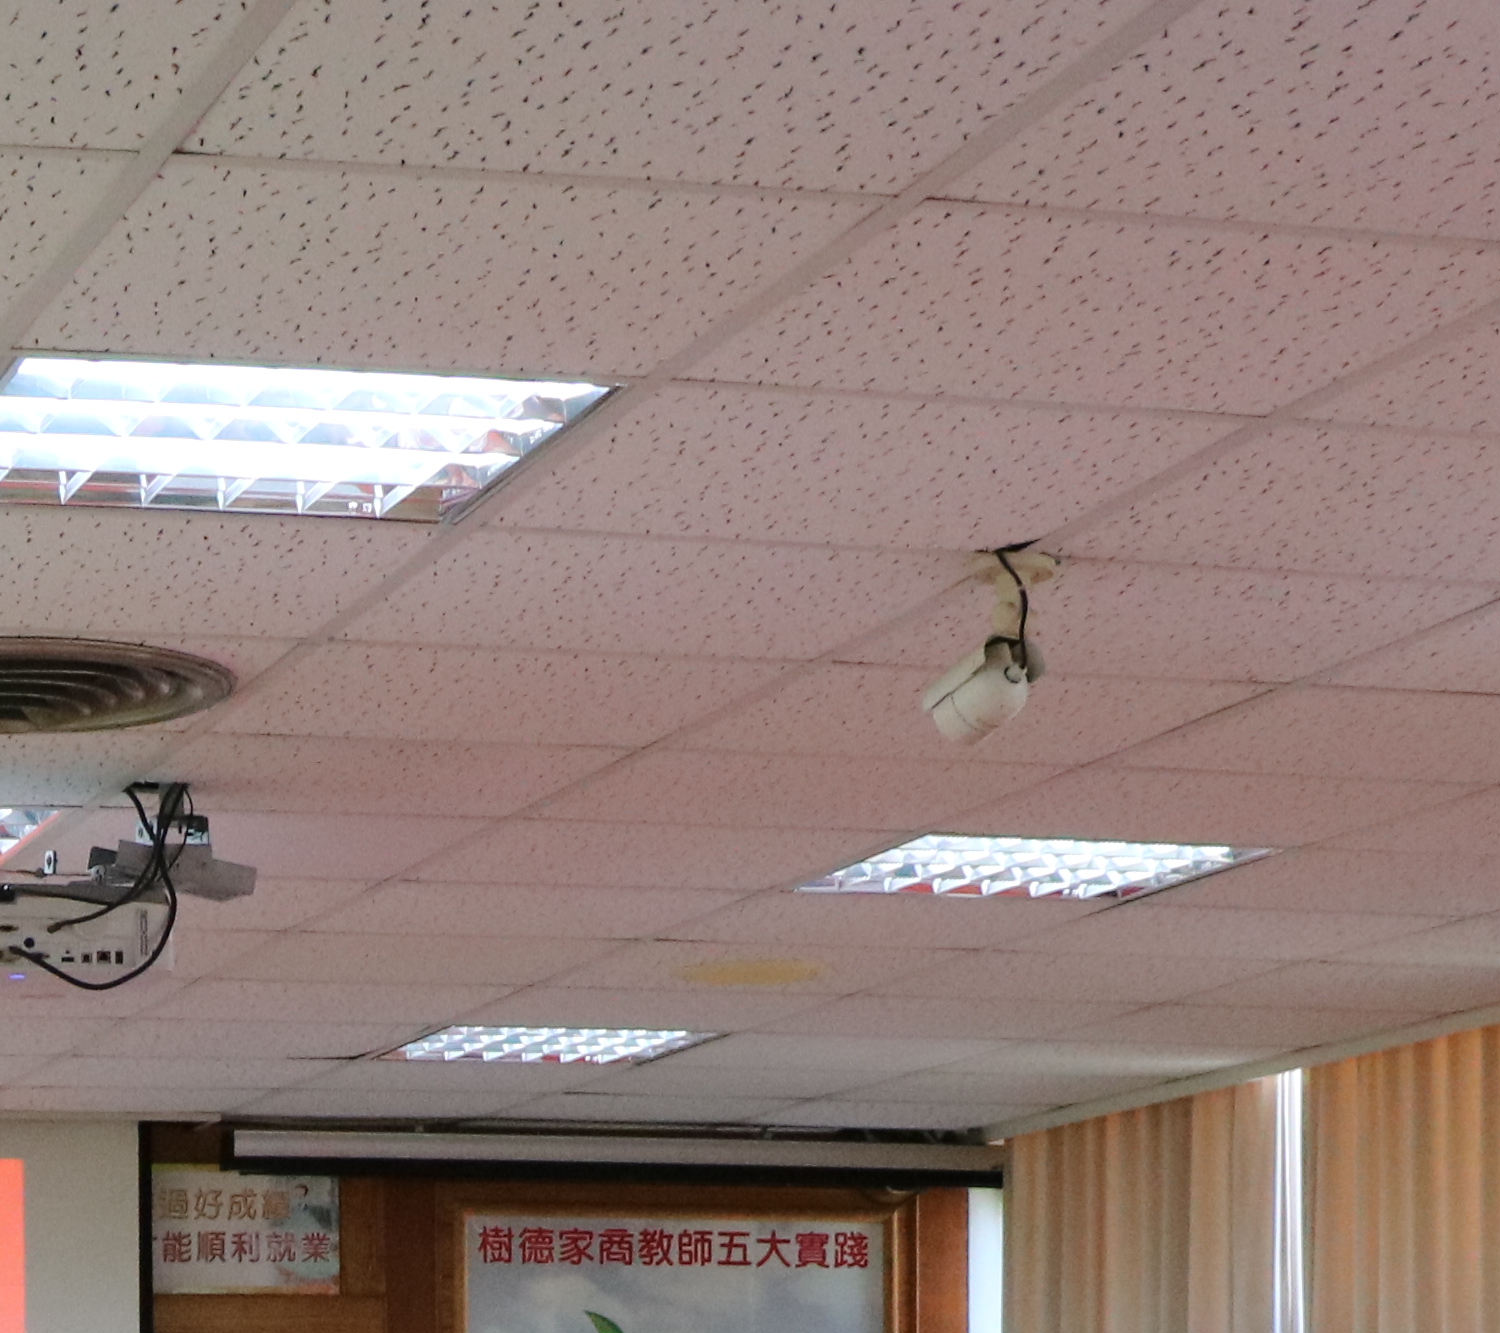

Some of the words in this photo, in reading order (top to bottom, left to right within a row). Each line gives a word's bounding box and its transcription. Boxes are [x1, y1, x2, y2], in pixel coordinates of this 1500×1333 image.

[153, 1230, 331, 1264] 能順利就業
[477, 1225, 869, 1269] 樹德家商教師五大實踐
